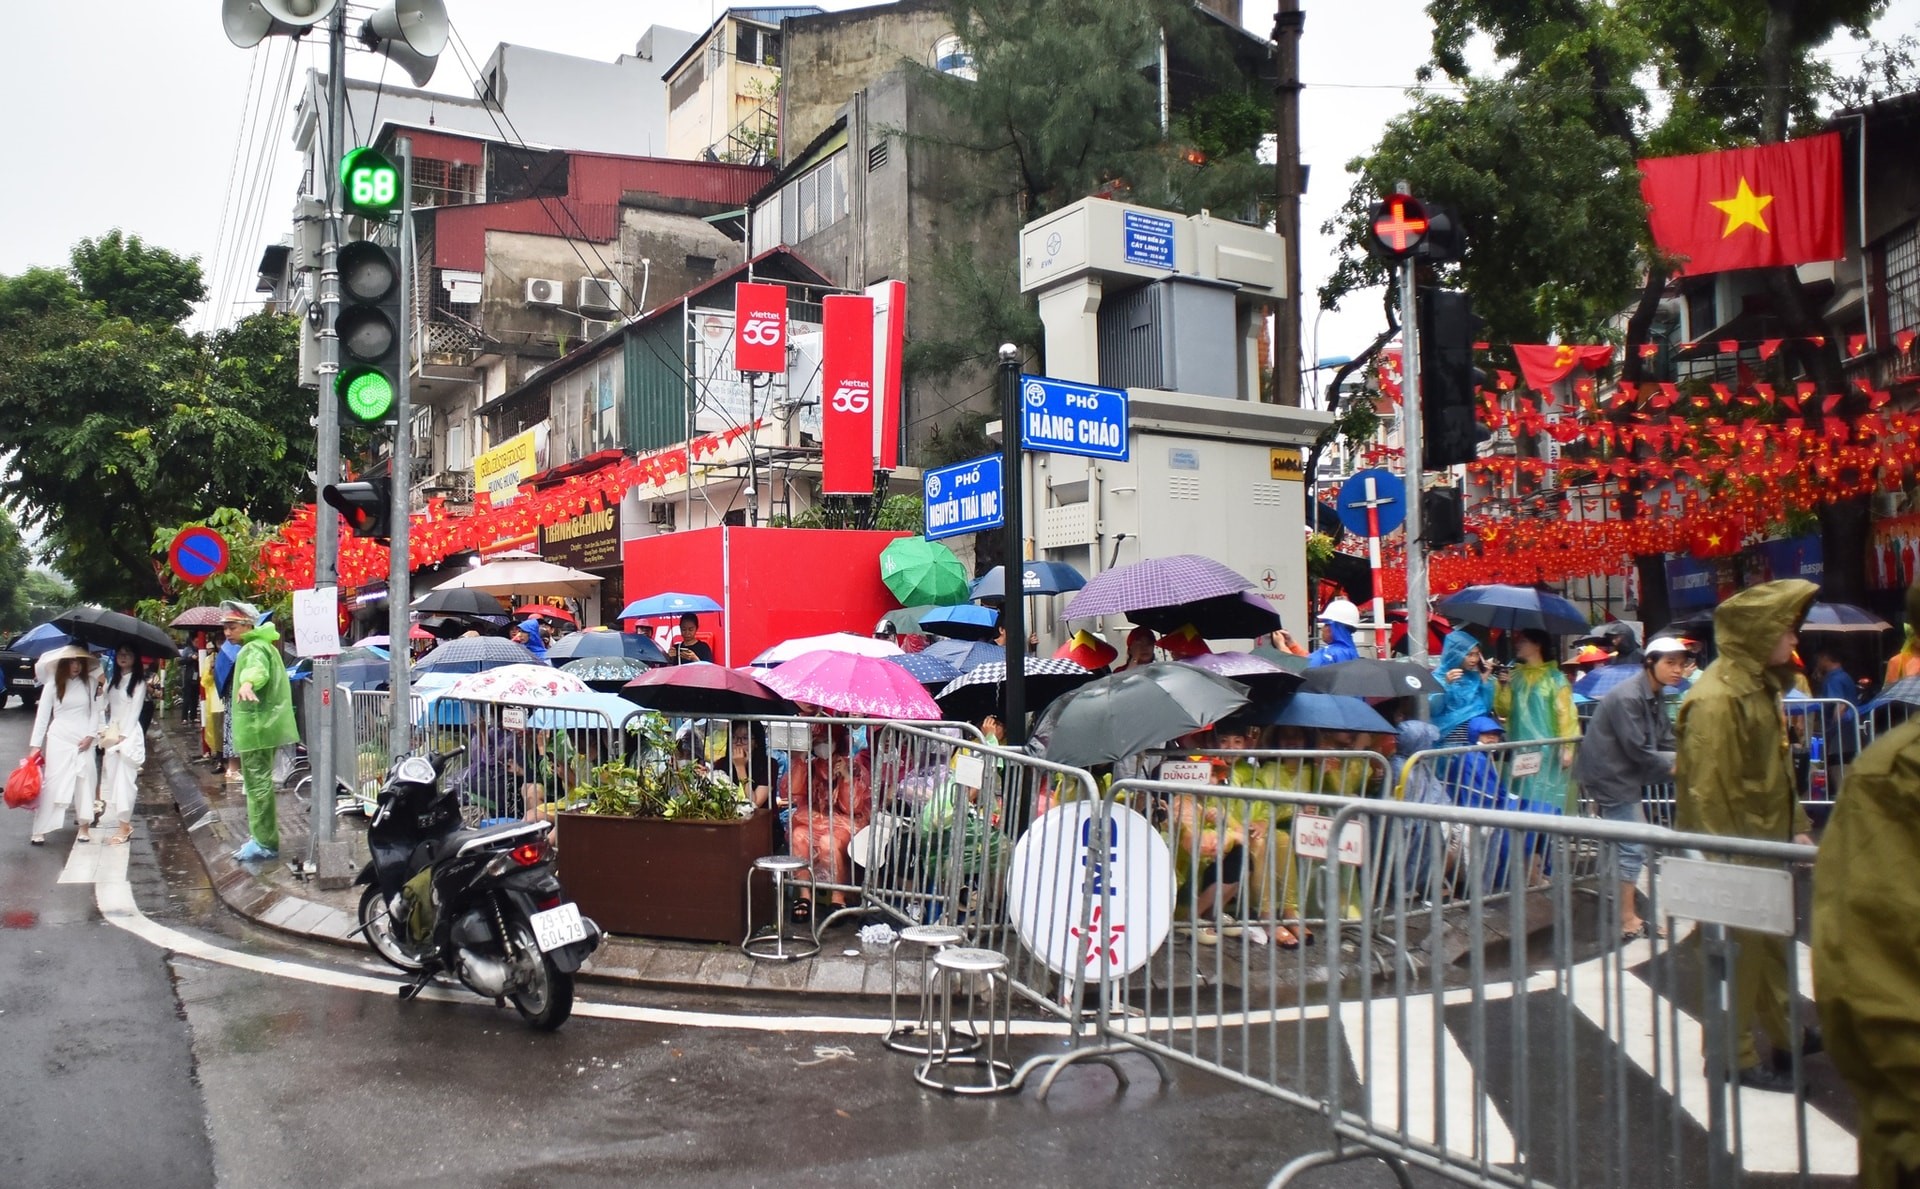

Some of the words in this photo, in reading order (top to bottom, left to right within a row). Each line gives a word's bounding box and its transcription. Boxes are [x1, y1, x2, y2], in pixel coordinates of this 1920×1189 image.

[352, 169, 396, 204] 68
[1131, 240, 1142, 249] CÁT
[1144, 243, 1158, 251] LINH
[750, 311, 780, 320] viettel
[743, 319, 780, 346] 5G
[840, 380, 869, 388] viettel
[832, 388, 869, 413] 5G
[1066, 393, 1099, 410] PHỐ
[1030, 408, 1074, 442] HÀNG
[1078, 417, 1119, 448] CHÁO
[955, 465, 980, 488] PHỐ
[930, 491, 959, 528] NGUYỄN
[961, 490, 978, 519] THÁI
[981, 490, 997, 521] HỌC
[539, 908, 574, 931] 29-F1
[541, 922, 582, 948] 604.79
